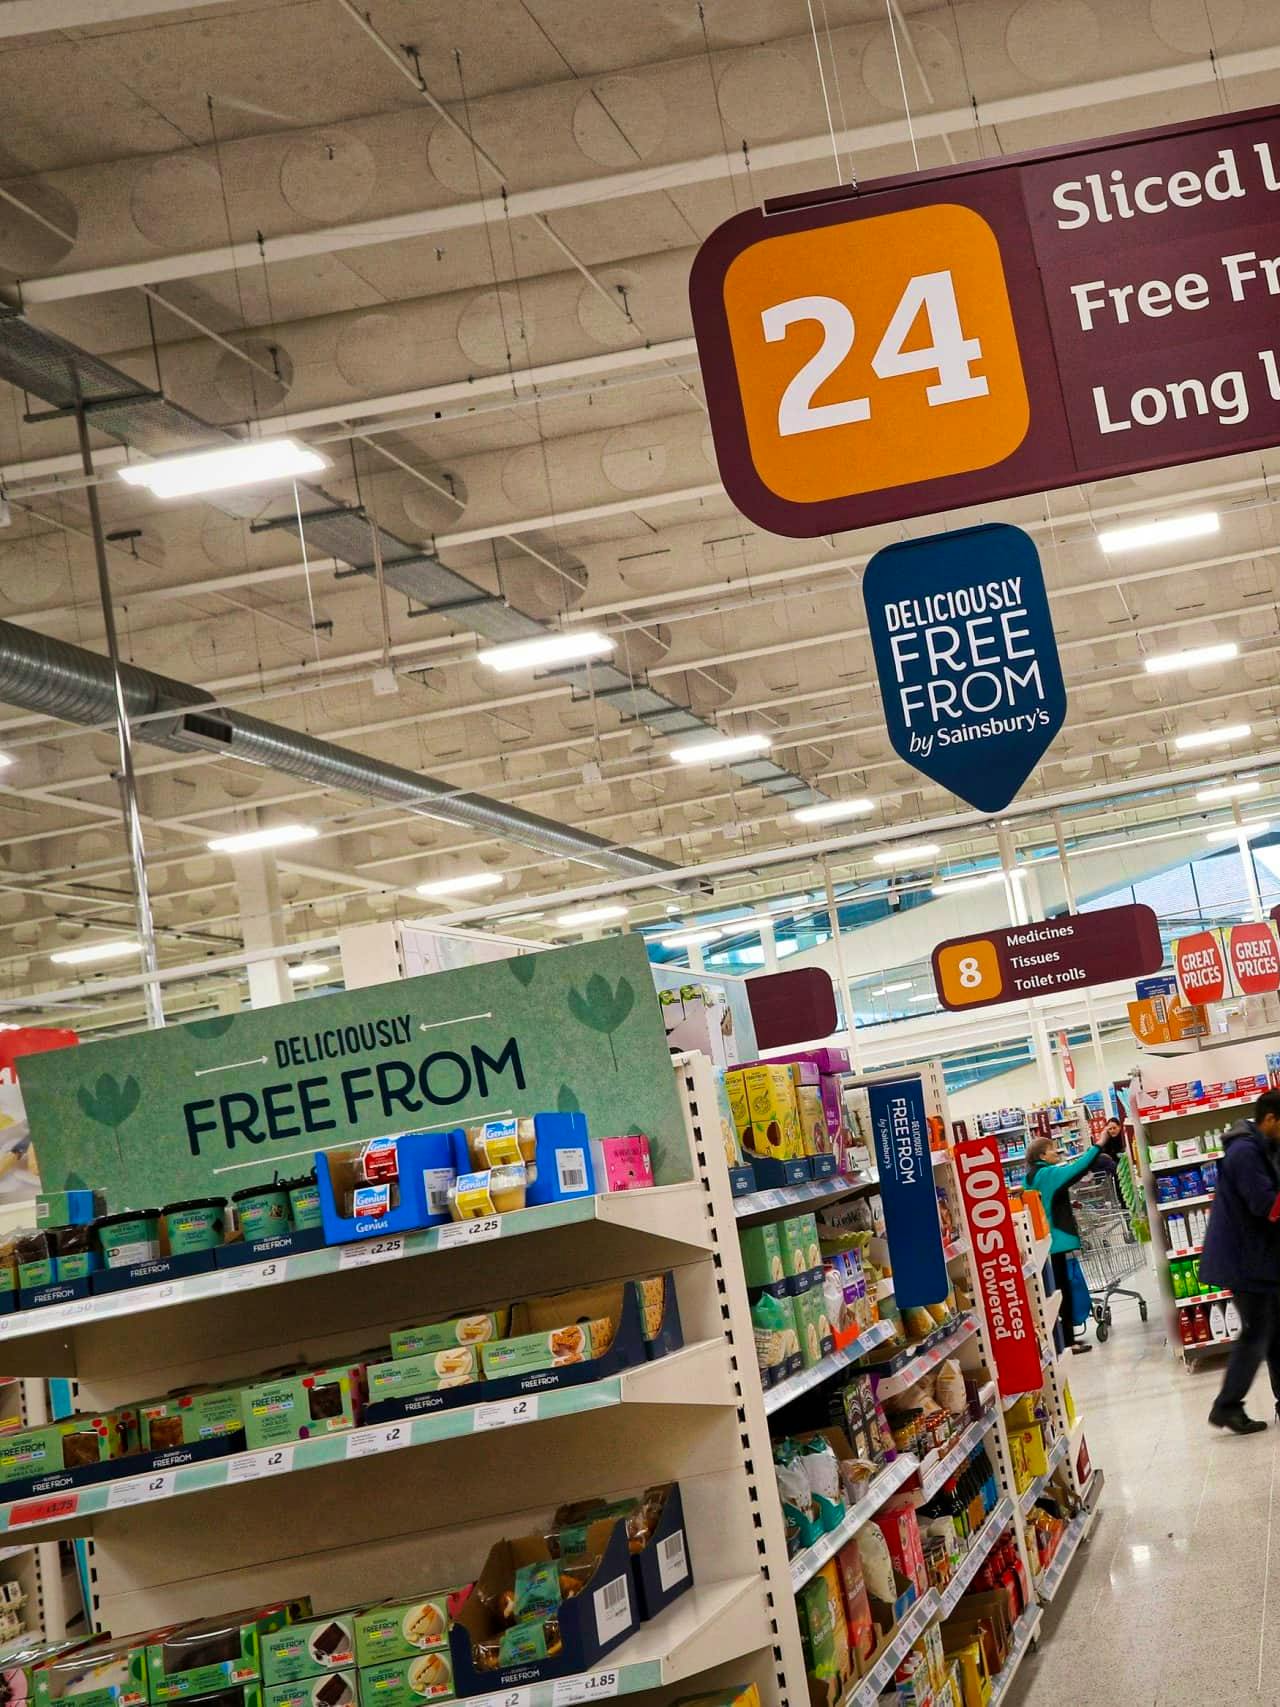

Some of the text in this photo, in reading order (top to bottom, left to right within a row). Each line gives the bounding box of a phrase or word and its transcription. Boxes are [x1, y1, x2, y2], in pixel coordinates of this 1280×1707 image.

[1053, 150, 1245, 229] Sliced
[1070, 274, 1209, 330] Free
[761, 271, 989, 436] 24
[1093, 372, 1249, 433] Long
[884, 577, 1021, 632] DELICIOUSLY
[890, 609, 1035, 682] FREE
[900, 660, 1044, 727] FROM
[909, 708, 1049, 757] by Sainsbury's
[1006, 925, 1074, 947] Medicines
[1235, 939, 1272, 959] GREAT
[1010, 951, 1060, 969] Tissues
[1181, 948, 1215, 971] GREAT
[1236, 957, 1278, 978] PRICES
[958, 957, 982, 988] 8
[1014, 968, 1086, 991] Toilet rolls
[1182, 965, 1222, 990] PRICES
[274, 1015, 412, 1069] DELICIOUSLY
[183, 1037, 526, 1156] FREE FROM
[486, 1122, 515, 1139] Genius
[881, 1128, 892, 1169] Sainsbury's
[891, 1098, 916, 1184] FREE FROM
[457, 1175, 489, 1192] Genius
[356, 1188, 388, 1207] Genius
[960, 1147, 1006, 1254] 100s
[355, 1217, 389, 1234] Genius
[469, 1220, 499, 1236] £2.25
[253, 1237, 292, 1253] FREE FROM
[371, 1239, 401, 1256] £2.25
[130, 1263, 170, 1278] FREE FROM
[262, 1264, 276, 1277] £3
[982, 1259, 1012, 1341] lowered
[998, 1254, 1026, 1341] of prices
[521, 1375, 559, 1390] FREE FROM
[405, 1397, 443, 1412] FREE FROM
[512, 1401, 527, 1415] £2
[386, 1428, 401, 1442] £2
[153, 1453, 192, 1469] FREE FROM
[268, 1452, 283, 1465] £2
[32, 1476, 73, 1493] FREE FROM
[149, 1478, 165, 1491] £2
[501, 1669, 541, 1685] FREE FROM
[585, 1674, 616, 1689] £1.85
